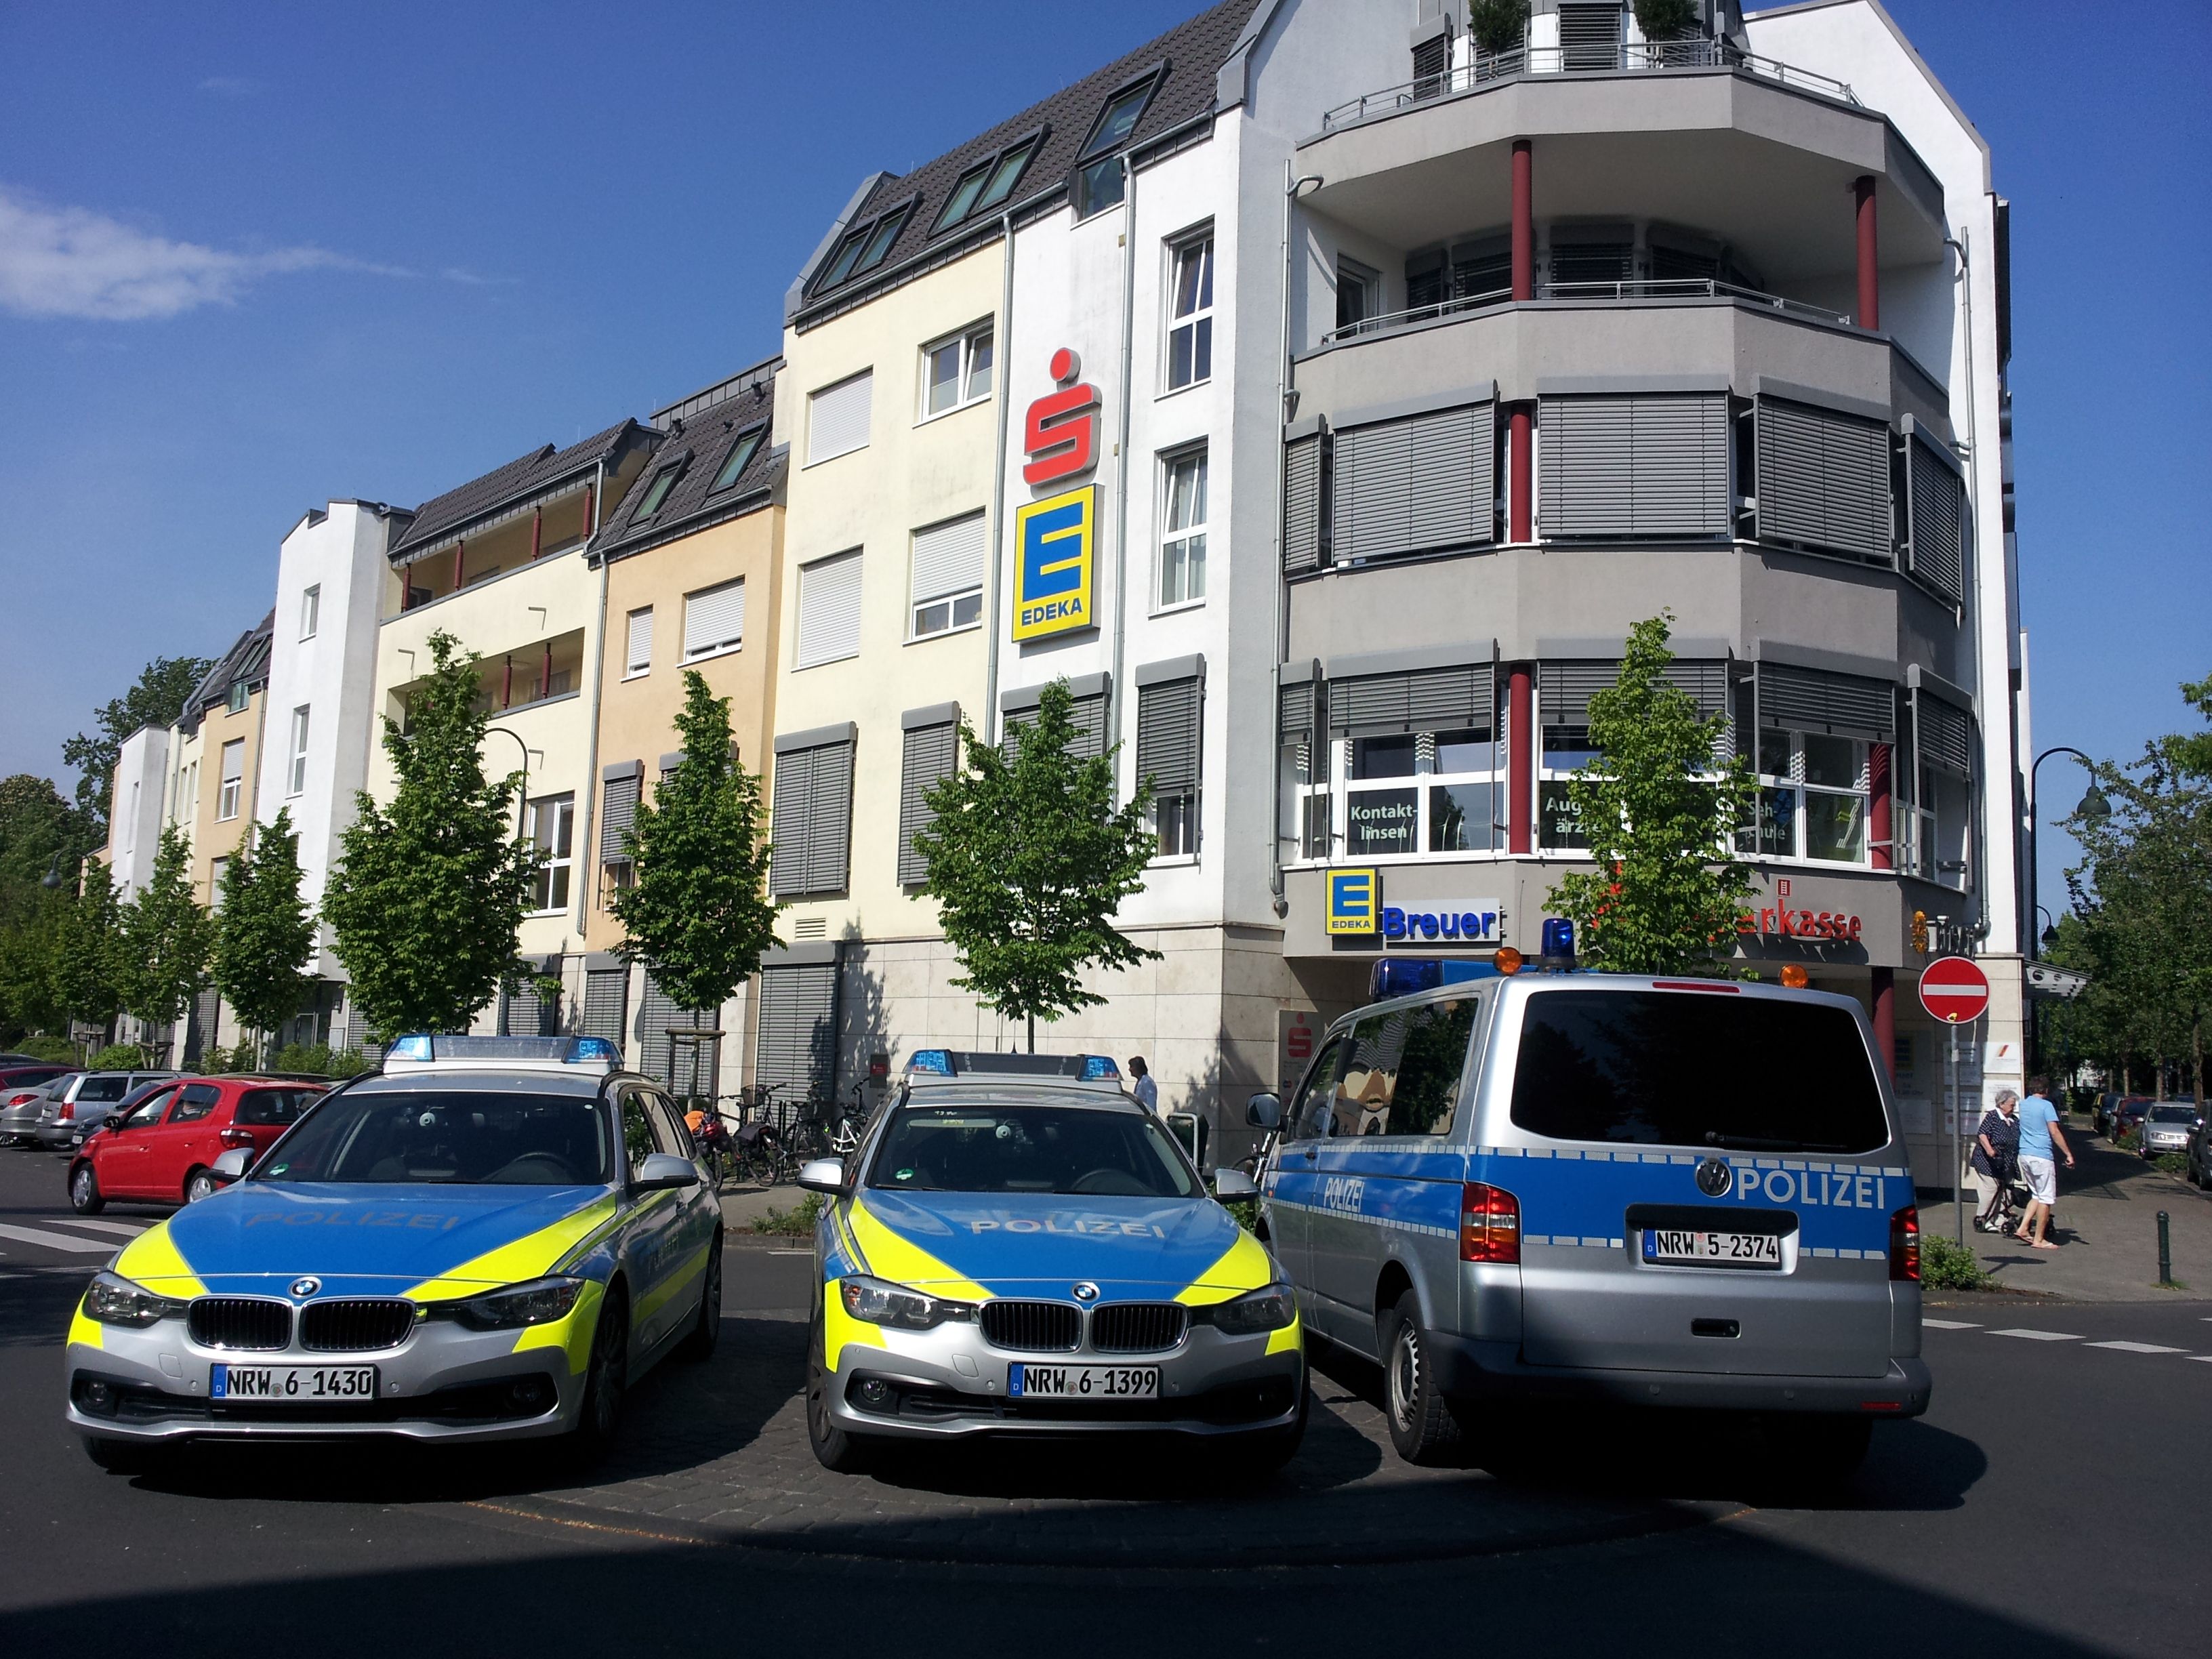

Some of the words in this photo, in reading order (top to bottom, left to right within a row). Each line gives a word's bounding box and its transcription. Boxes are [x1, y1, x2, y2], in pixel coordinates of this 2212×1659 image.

[1021, 597, 1082, 627] EDEKA
[1351, 802, 1418, 821] Kontakt-
[1361, 825, 1407, 840] linsen
[1332, 920, 1371, 928] EDEKA
[1383, 907, 1496, 937] Breuer
[1324, 1177, 1365, 1213] POLIZEI
[1738, 1168, 1885, 1210] POLIZEI
[245, 1211, 460, 1230] POLIZEI
[970, 1219, 1166, 1238] POLIZEI
[1657, 1231, 1694, 1255] NRW
[1707, 1234, 1778, 1259] 5-2374
[226, 1370, 271, 1395] NRW
[285, 1370, 372, 1395] 6-1430
[1023, 1368, 1067, 1393] NRW
[1079, 1370, 1156, 1395] 6-1399
